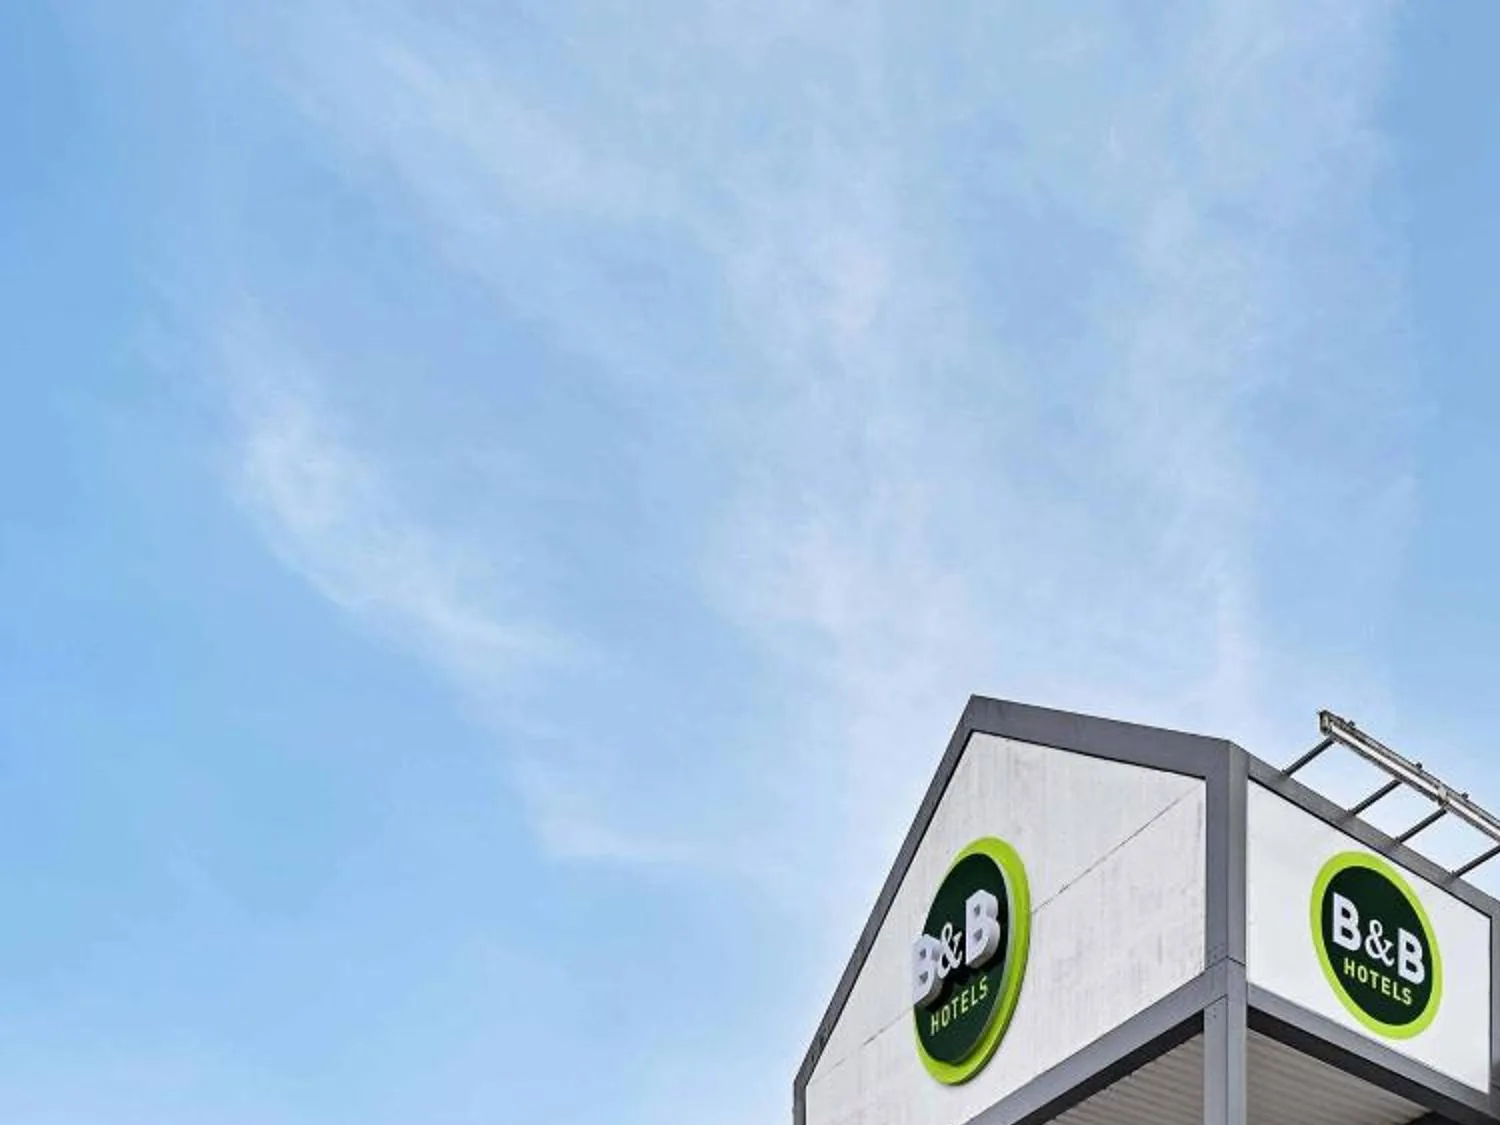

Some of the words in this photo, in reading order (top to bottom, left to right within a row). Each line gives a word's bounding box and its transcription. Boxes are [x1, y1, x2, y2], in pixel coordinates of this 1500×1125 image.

[912, 890, 1000, 1008] B&B
[1333, 892, 1425, 985] B&B
[931, 975, 988, 1036] HOTELS
[1344, 957, 1412, 1006] HOTELS
